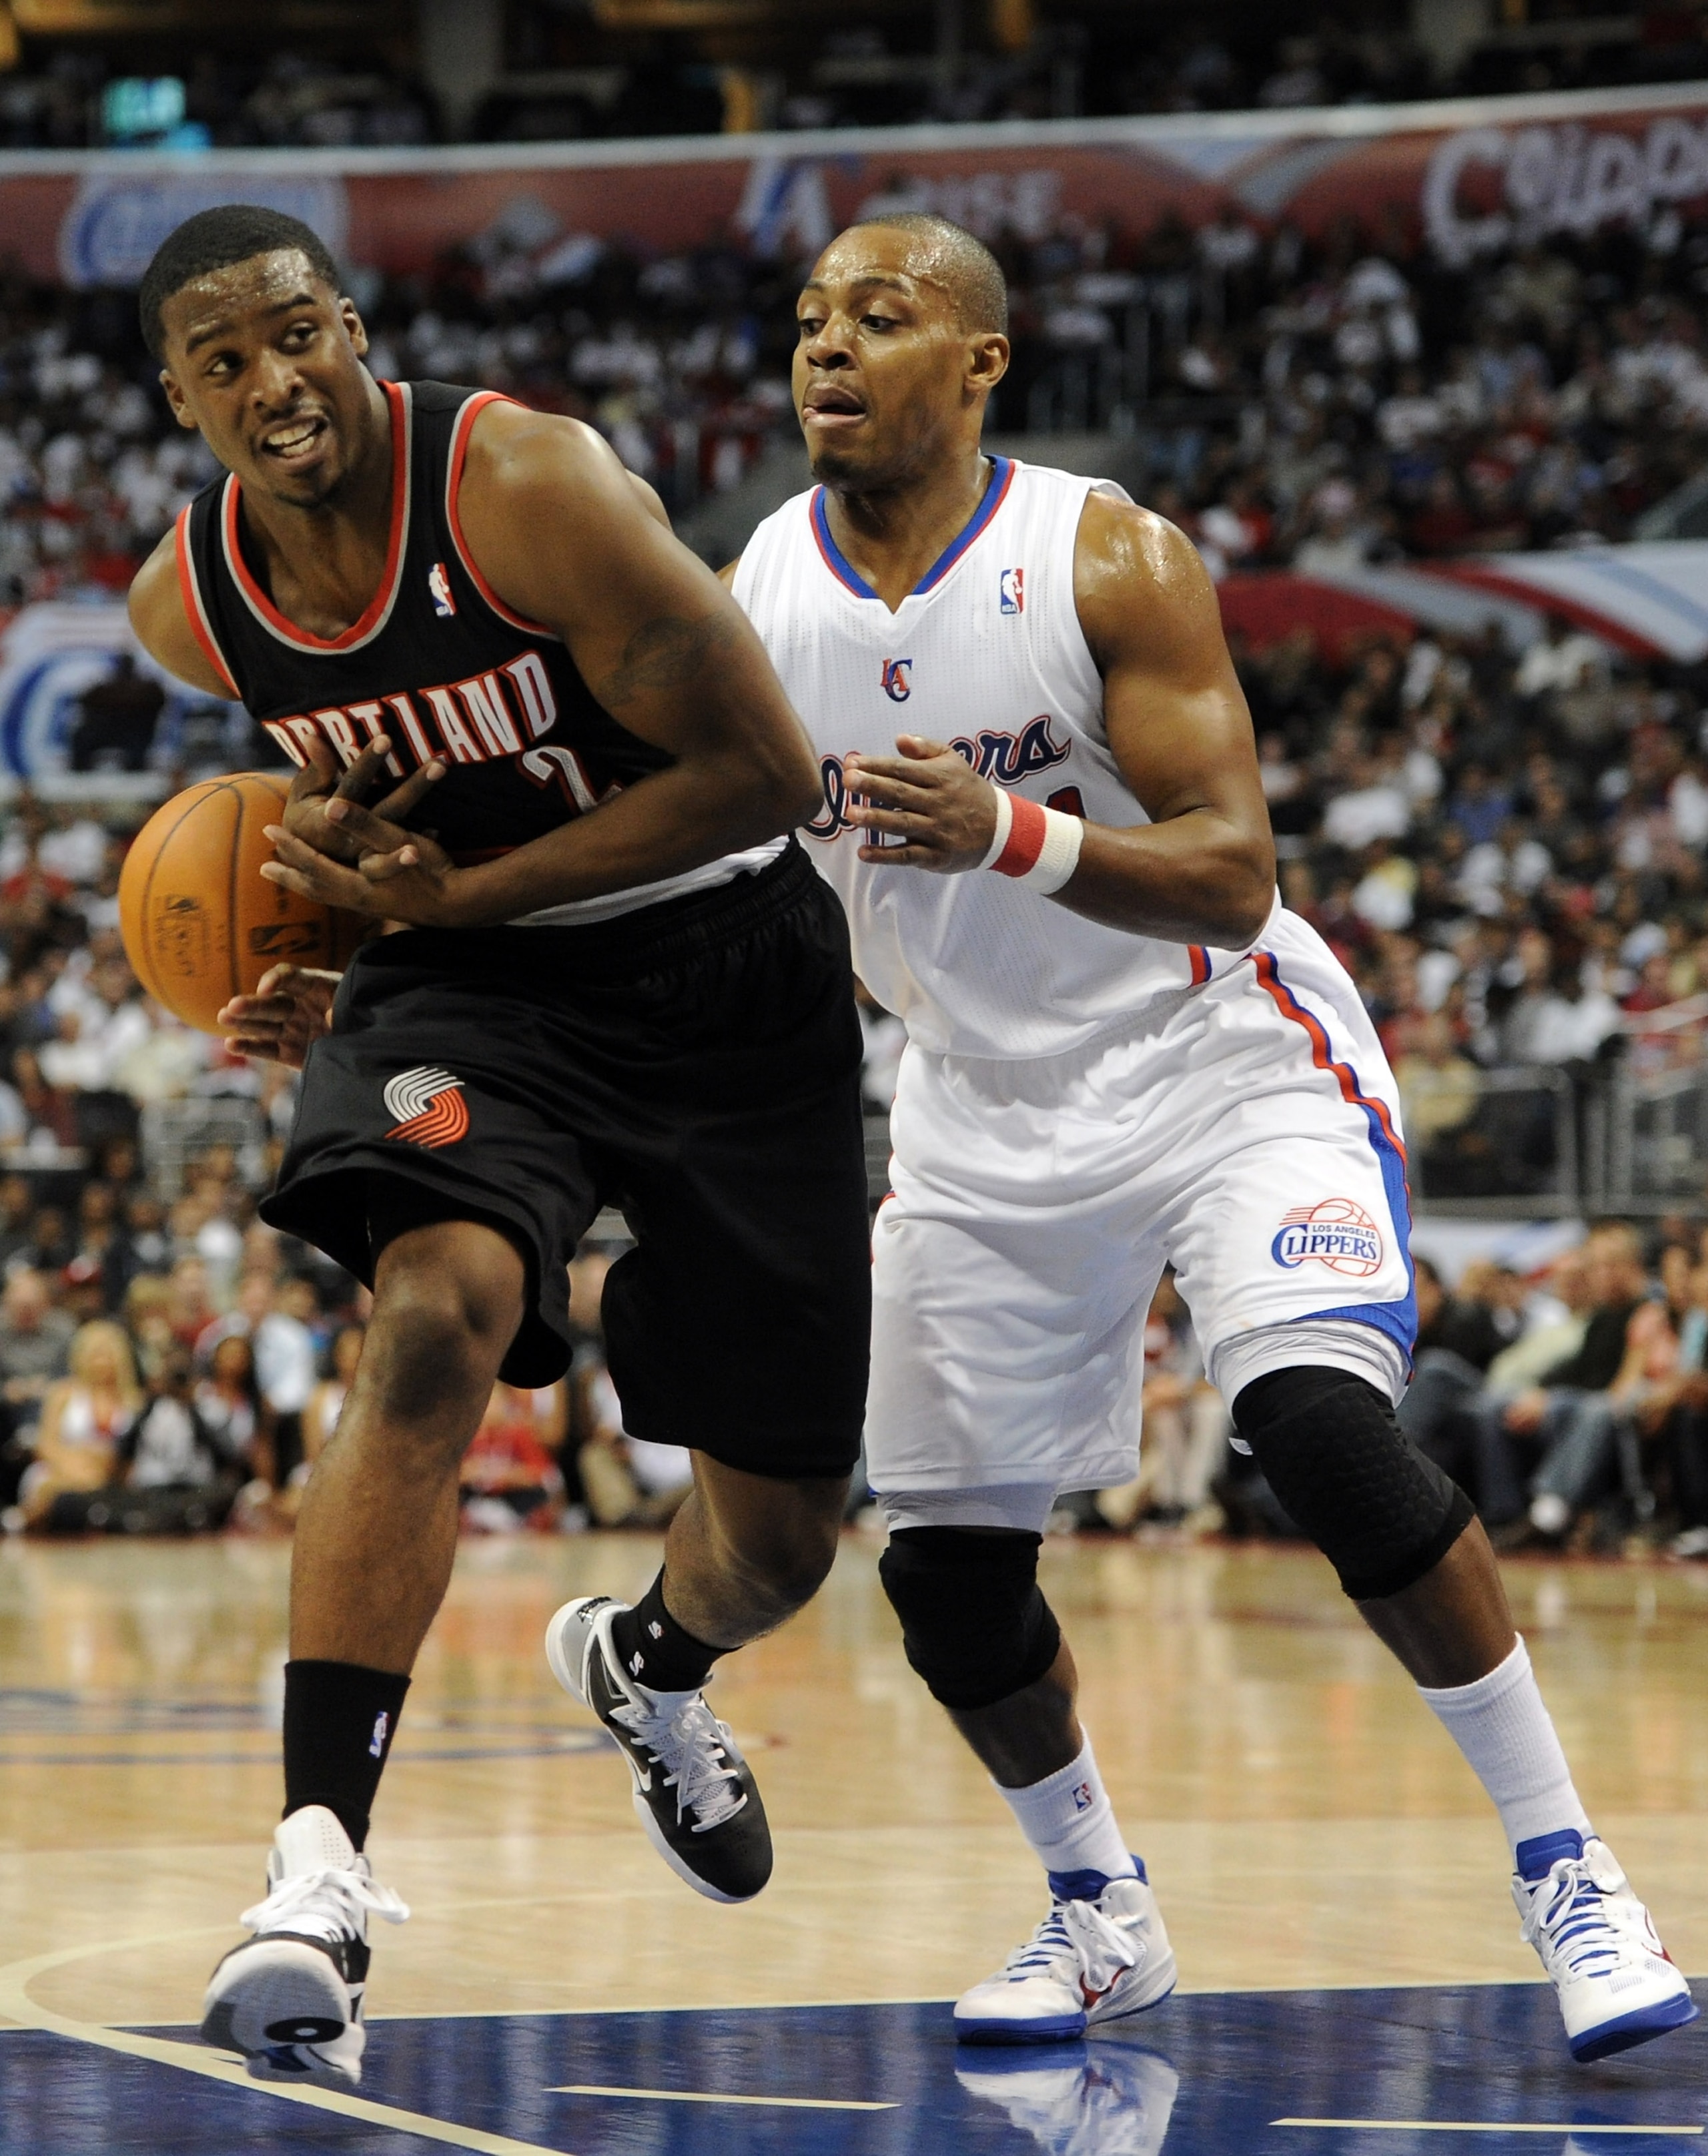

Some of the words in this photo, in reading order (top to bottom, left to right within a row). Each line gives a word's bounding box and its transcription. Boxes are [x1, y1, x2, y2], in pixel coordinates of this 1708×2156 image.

[516, 743, 626, 815] 2
[1272, 1223, 1376, 1269] CLIPPERS
[1334, 1225, 1375, 1238] ANGELES
